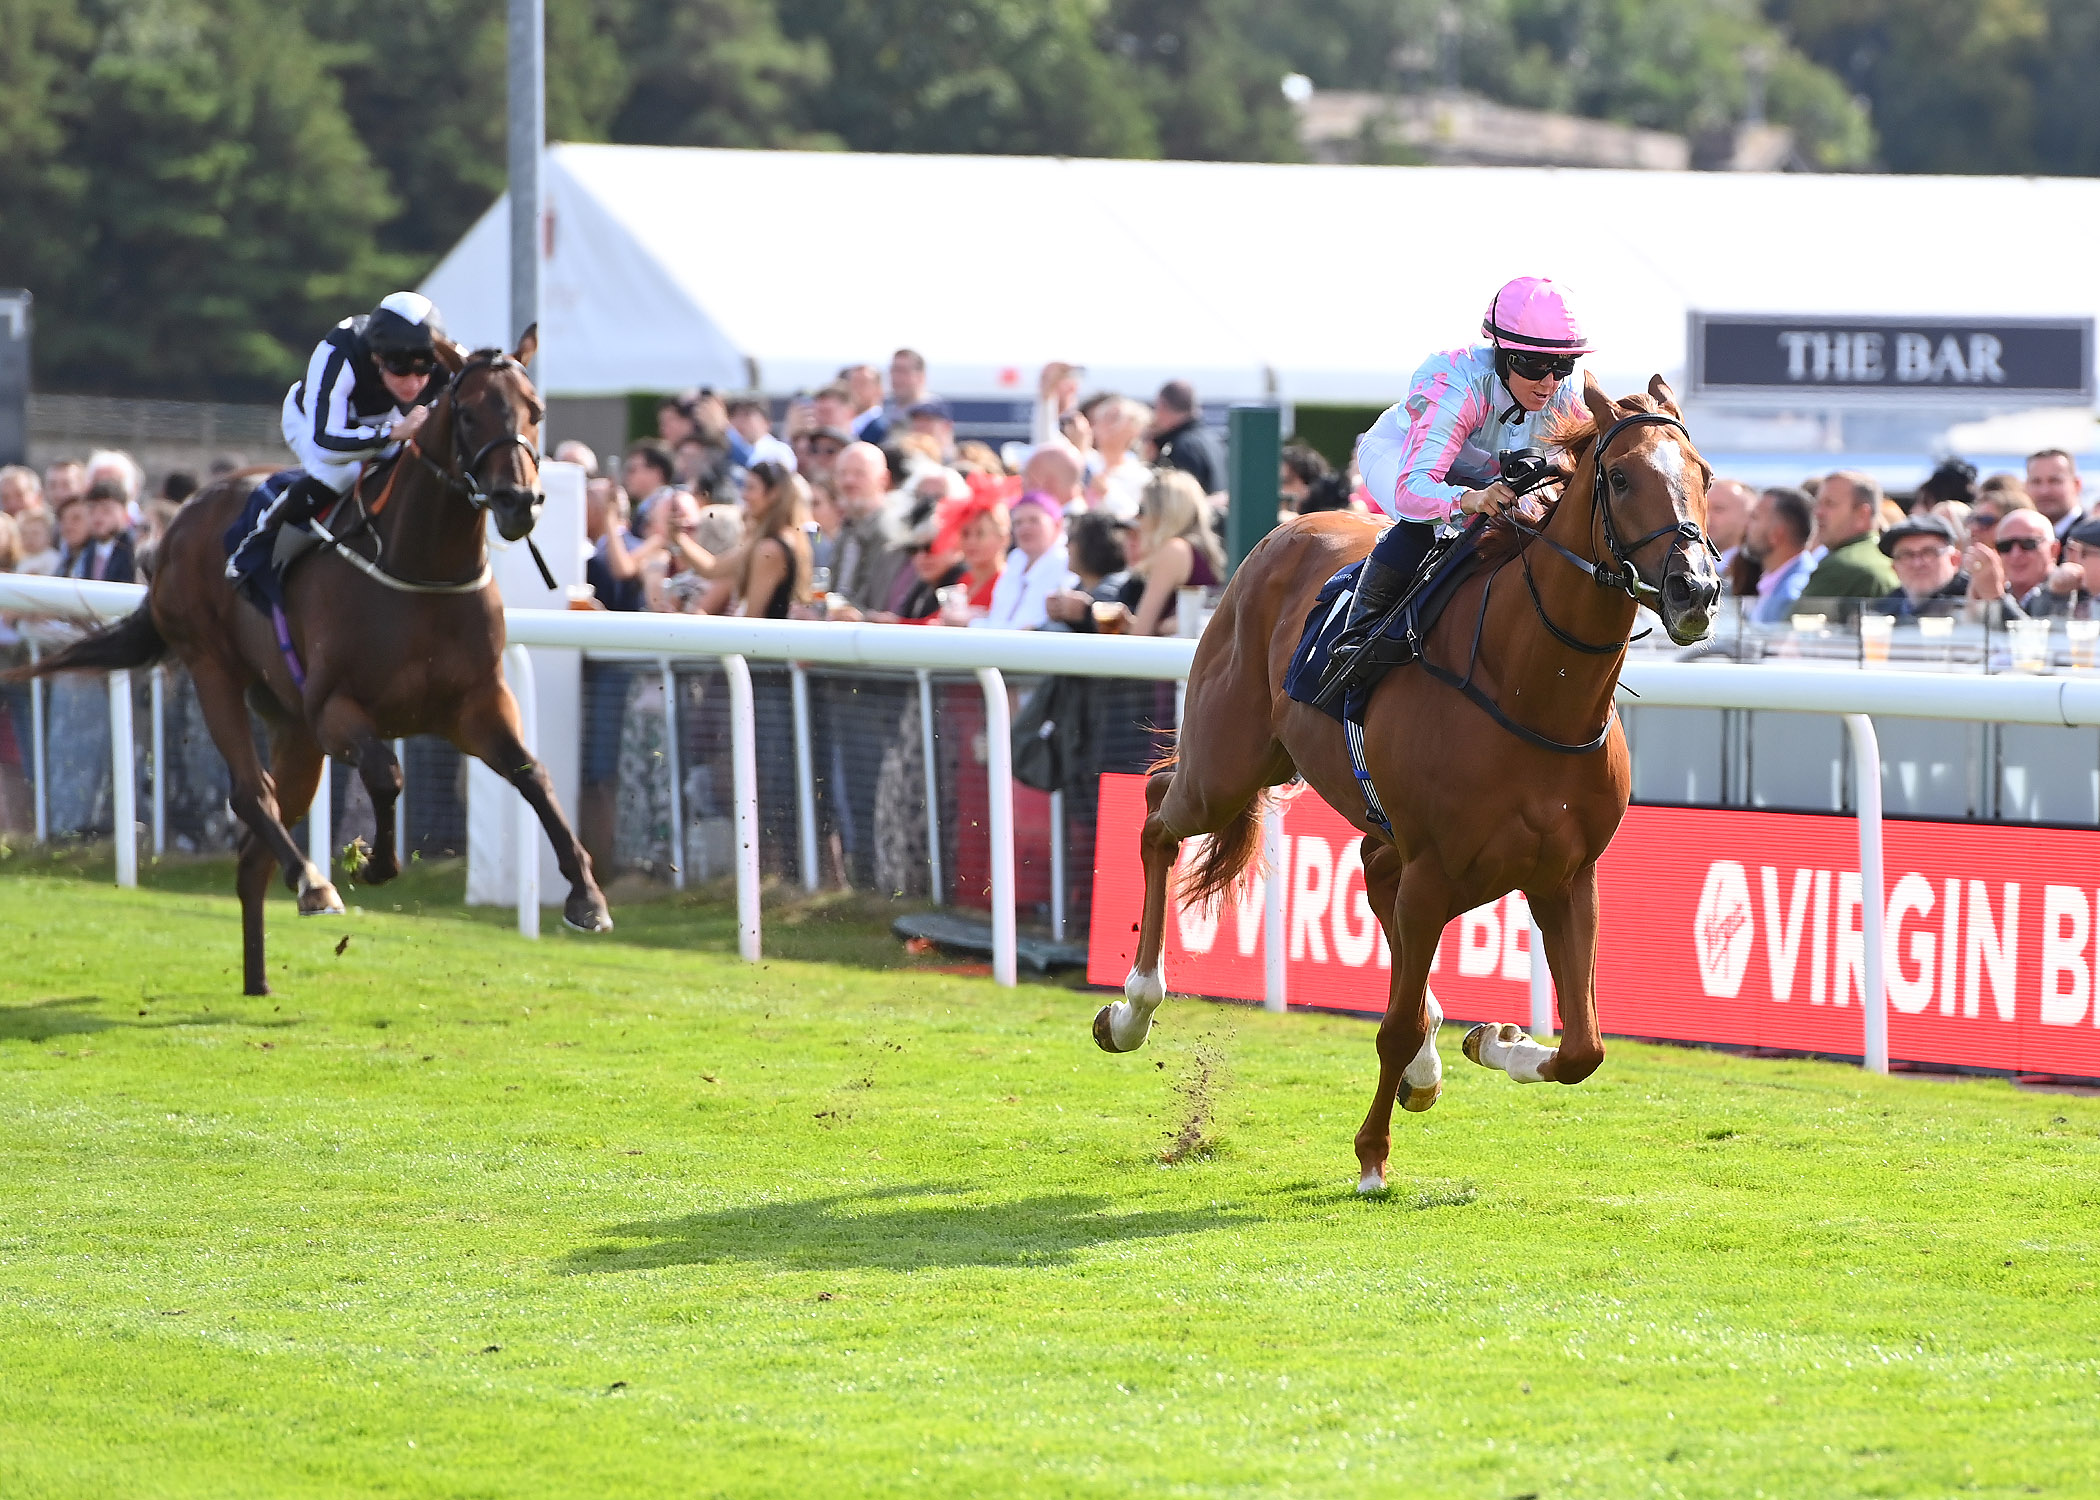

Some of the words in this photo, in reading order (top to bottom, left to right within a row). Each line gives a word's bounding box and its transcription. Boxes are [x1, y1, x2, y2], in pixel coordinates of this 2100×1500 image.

[1777, 331, 1886, 381] THE
[1896, 332, 2006, 383] BAR
[1761, 865, 2020, 1022] VIRGIN
[2040, 884, 2100, 1029] B
